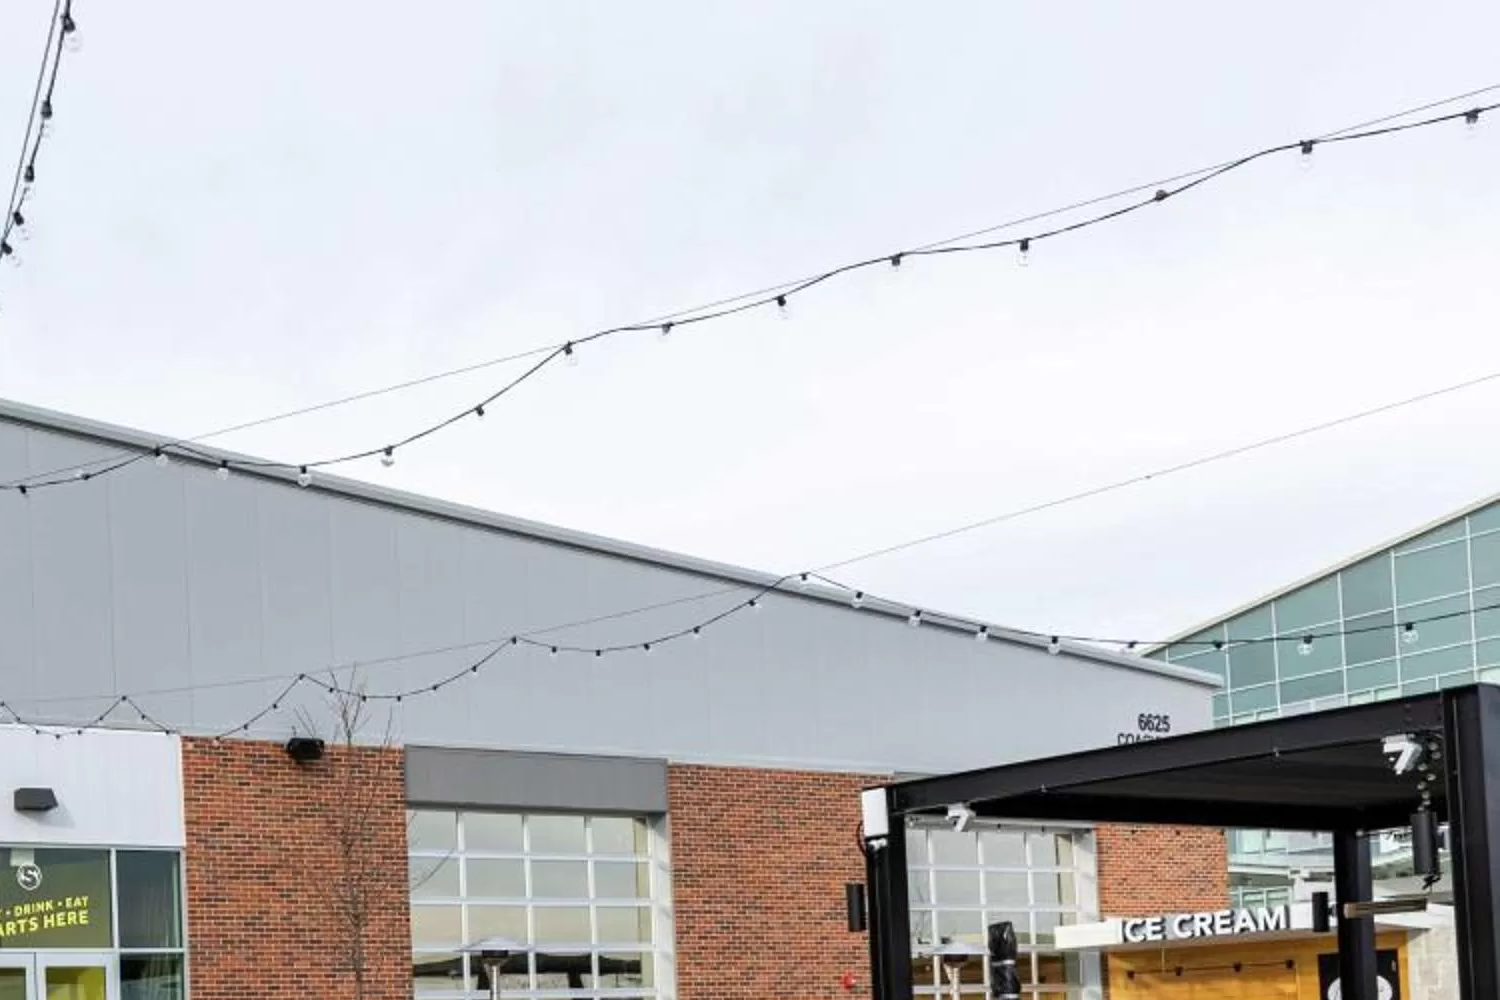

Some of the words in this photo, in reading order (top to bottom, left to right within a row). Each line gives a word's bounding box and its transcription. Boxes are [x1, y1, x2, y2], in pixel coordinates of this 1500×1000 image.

[1137, 713, 1171, 733] 6625
[14, 899, 54, 917] DRINK
[65, 896, 89, 909] EAT
[43, 909, 89, 929] HERE
[1120, 917, 1167, 943] ICE
[1173, 904, 1288, 939] CREAM
